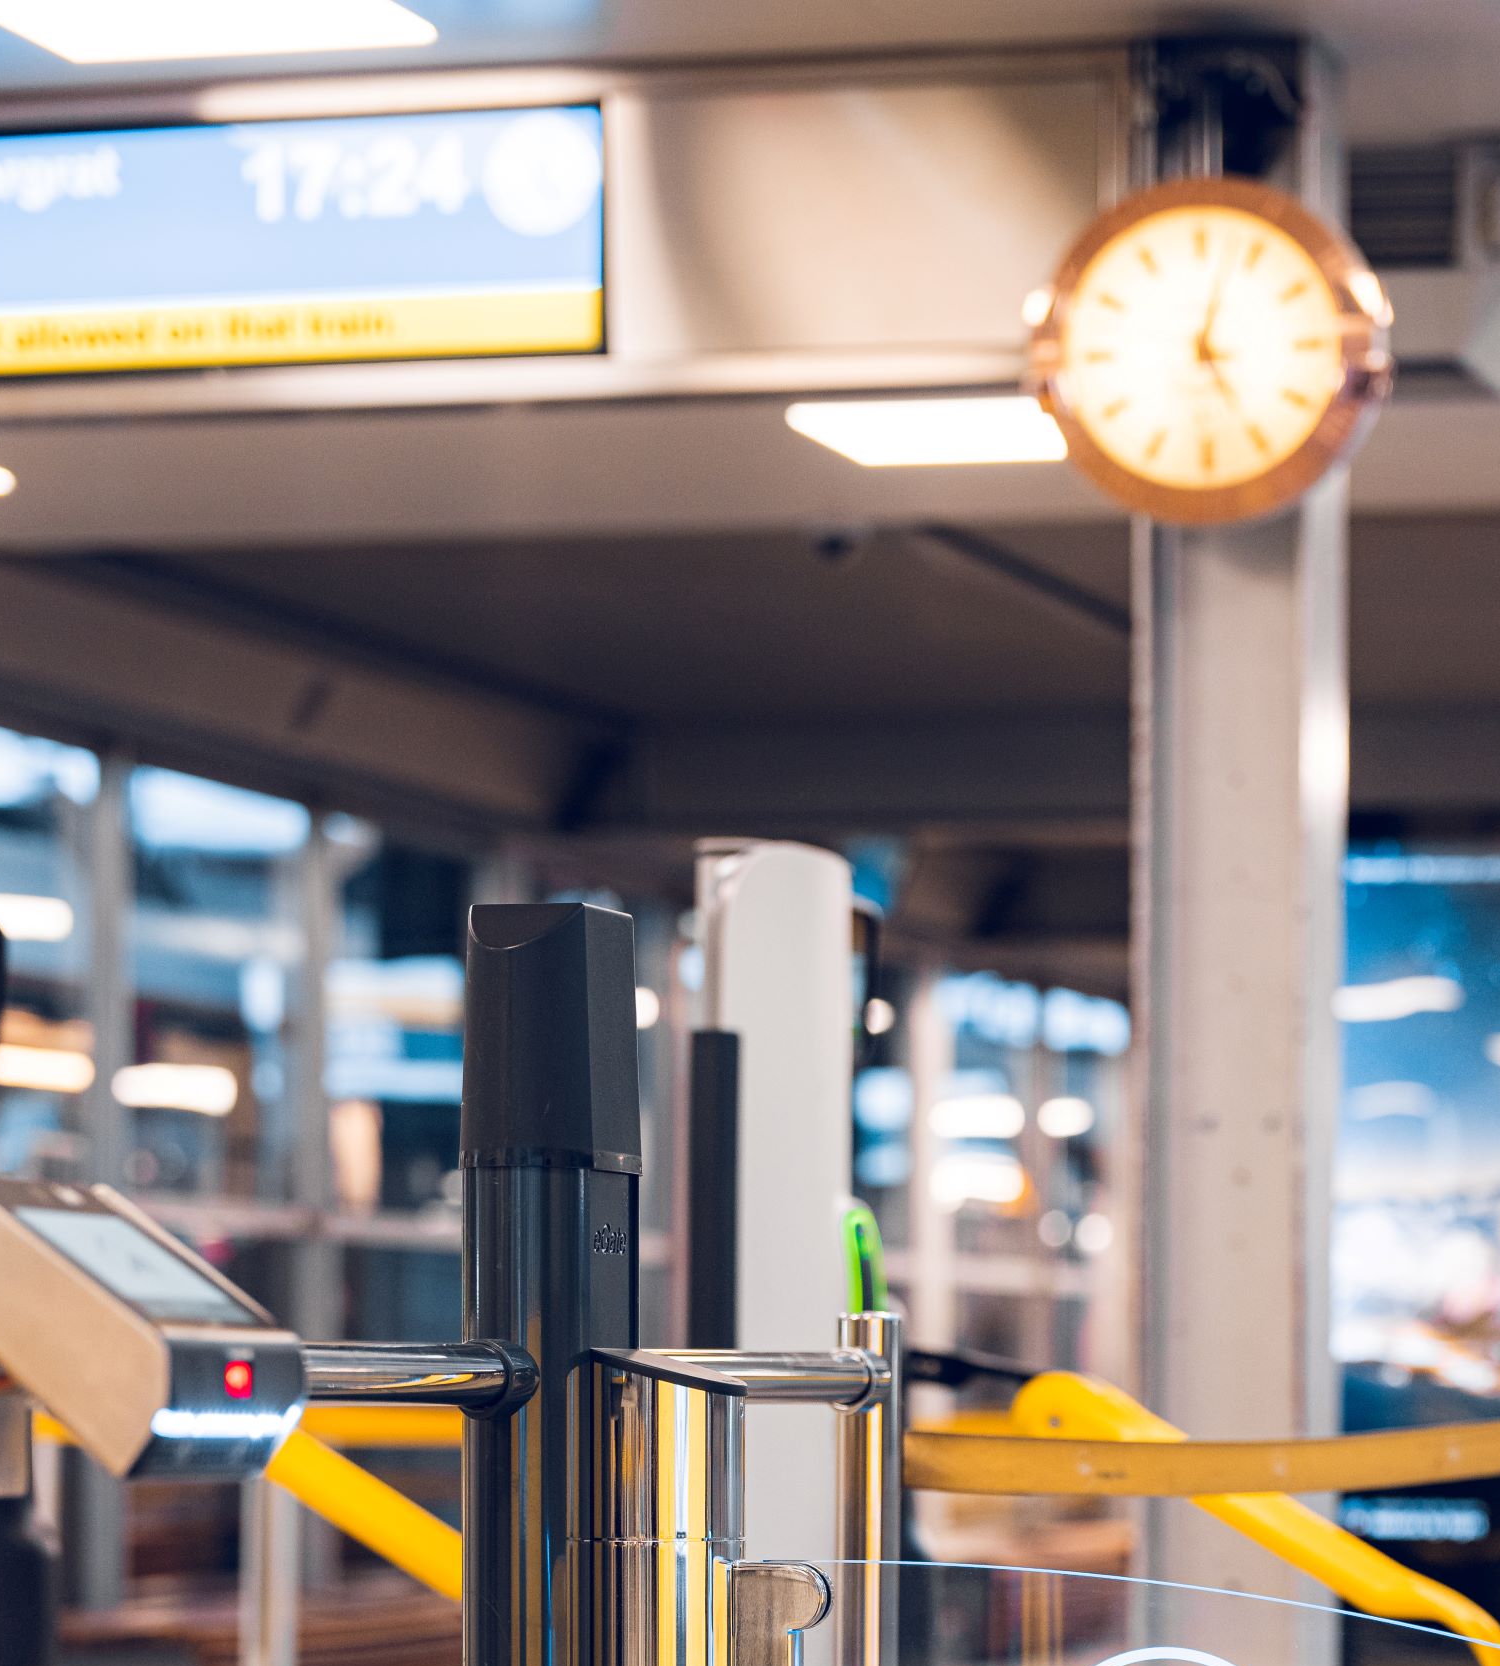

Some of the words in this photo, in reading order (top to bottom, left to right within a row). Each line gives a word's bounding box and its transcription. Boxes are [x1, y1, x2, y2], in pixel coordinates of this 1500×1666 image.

[241, 132, 470, 221] 17:24
[11, 317, 150, 353] allowed
[165, 319, 209, 346] on
[593, 1223, 627, 1255] eGate
